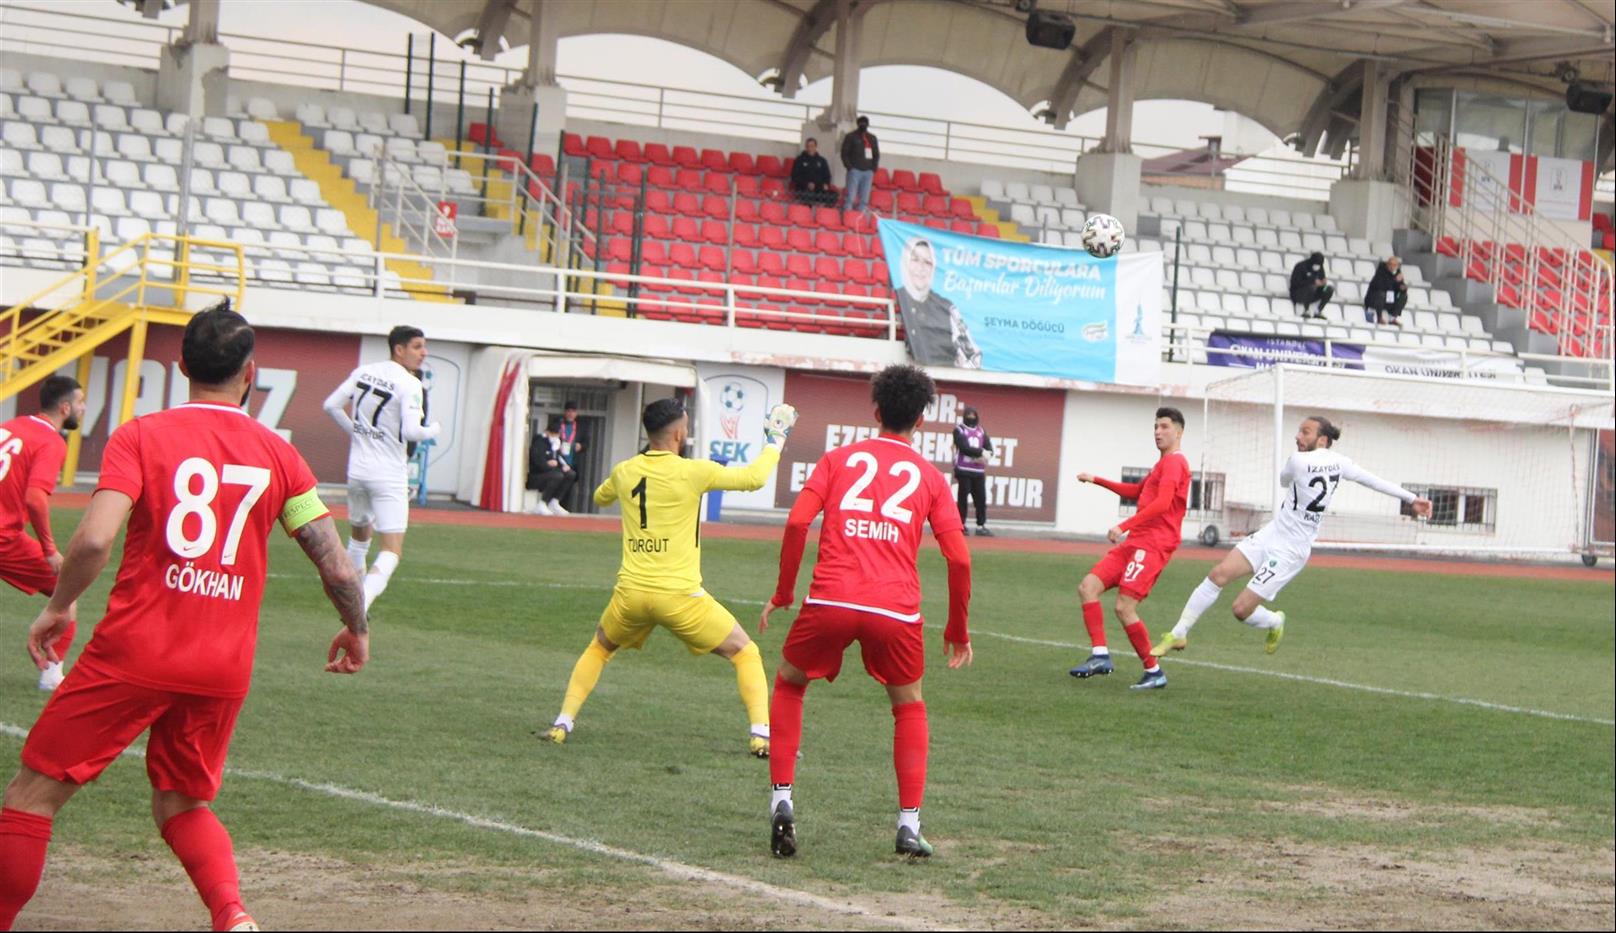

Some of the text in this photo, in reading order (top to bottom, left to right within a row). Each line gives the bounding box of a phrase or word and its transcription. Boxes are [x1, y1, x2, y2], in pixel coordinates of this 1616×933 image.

[941, 245, 1101, 281] TÜM SPORCULARA
[1023, 276, 1106, 305] Diliyorum
[356, 380, 393, 428] 77
[709, 440, 751, 463] SEK
[631, 476, 647, 530] 1
[839, 451, 922, 524] 22
[1305, 473, 1341, 513] 27
[166, 457, 271, 566] 87
[628, 538, 669, 553] TURGUT
[165, 561, 245, 601] GÖKHAN
[1124, 561, 1145, 580] 97
[1255, 567, 1276, 585] 27
